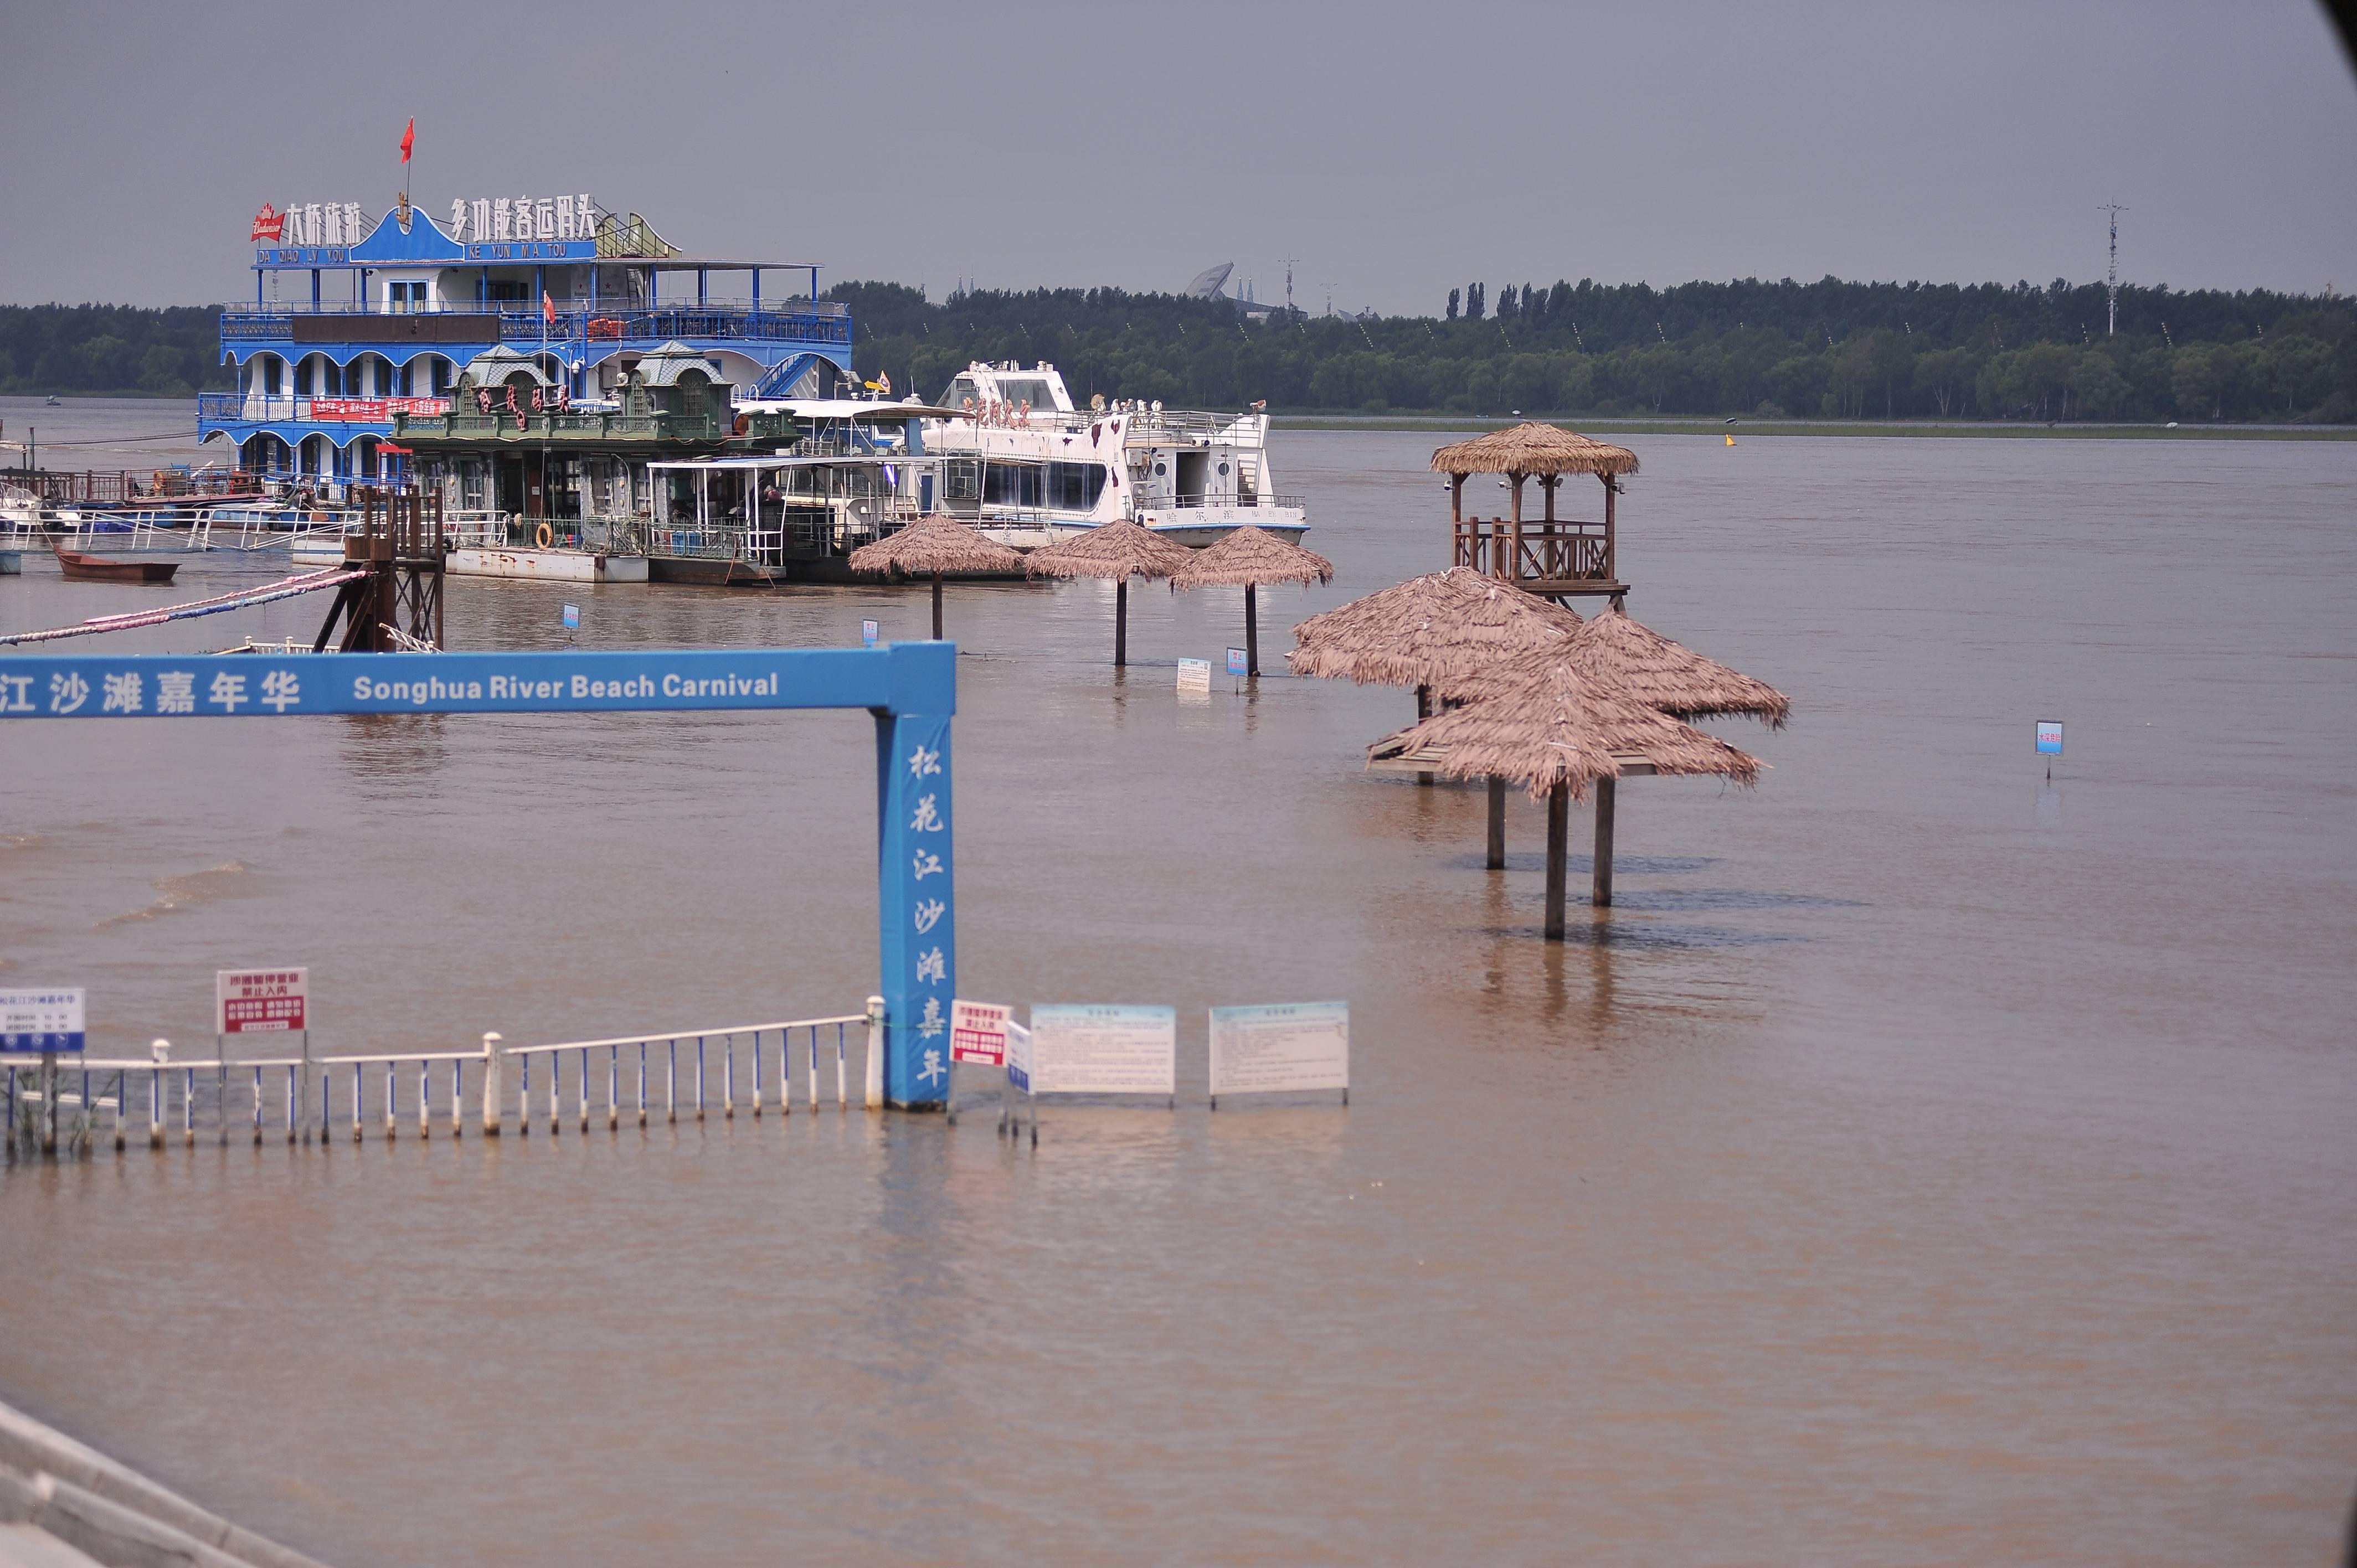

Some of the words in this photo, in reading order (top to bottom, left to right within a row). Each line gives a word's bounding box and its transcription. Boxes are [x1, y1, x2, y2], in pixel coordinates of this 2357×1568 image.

[253, 220, 281, 234] Budweiser
[287, 202, 361, 245] 大桥旅游
[451, 194, 596, 241] 多功能客运码头
[259, 250, 270, 263] DA
[279, 250, 299, 263] QIAO
[327, 249, 344, 263] YOU
[469, 246, 481, 259] KE
[492, 245, 511, 259] YUN
[548, 244, 567, 257] TOU
[1166, 509, 1234, 523] 哈尔滨
[0, 671, 300, 714] 江沙滩嘉年华
[354, 675, 482, 705] Songhua
[490, 675, 563, 699] River
[571, 674, 656, 699] Beach
[662, 672, 778, 698] Carnival
[908, 745, 948, 1088] 松花江沙滩嘉年
[242, 986, 287, 997] 禁止入内
